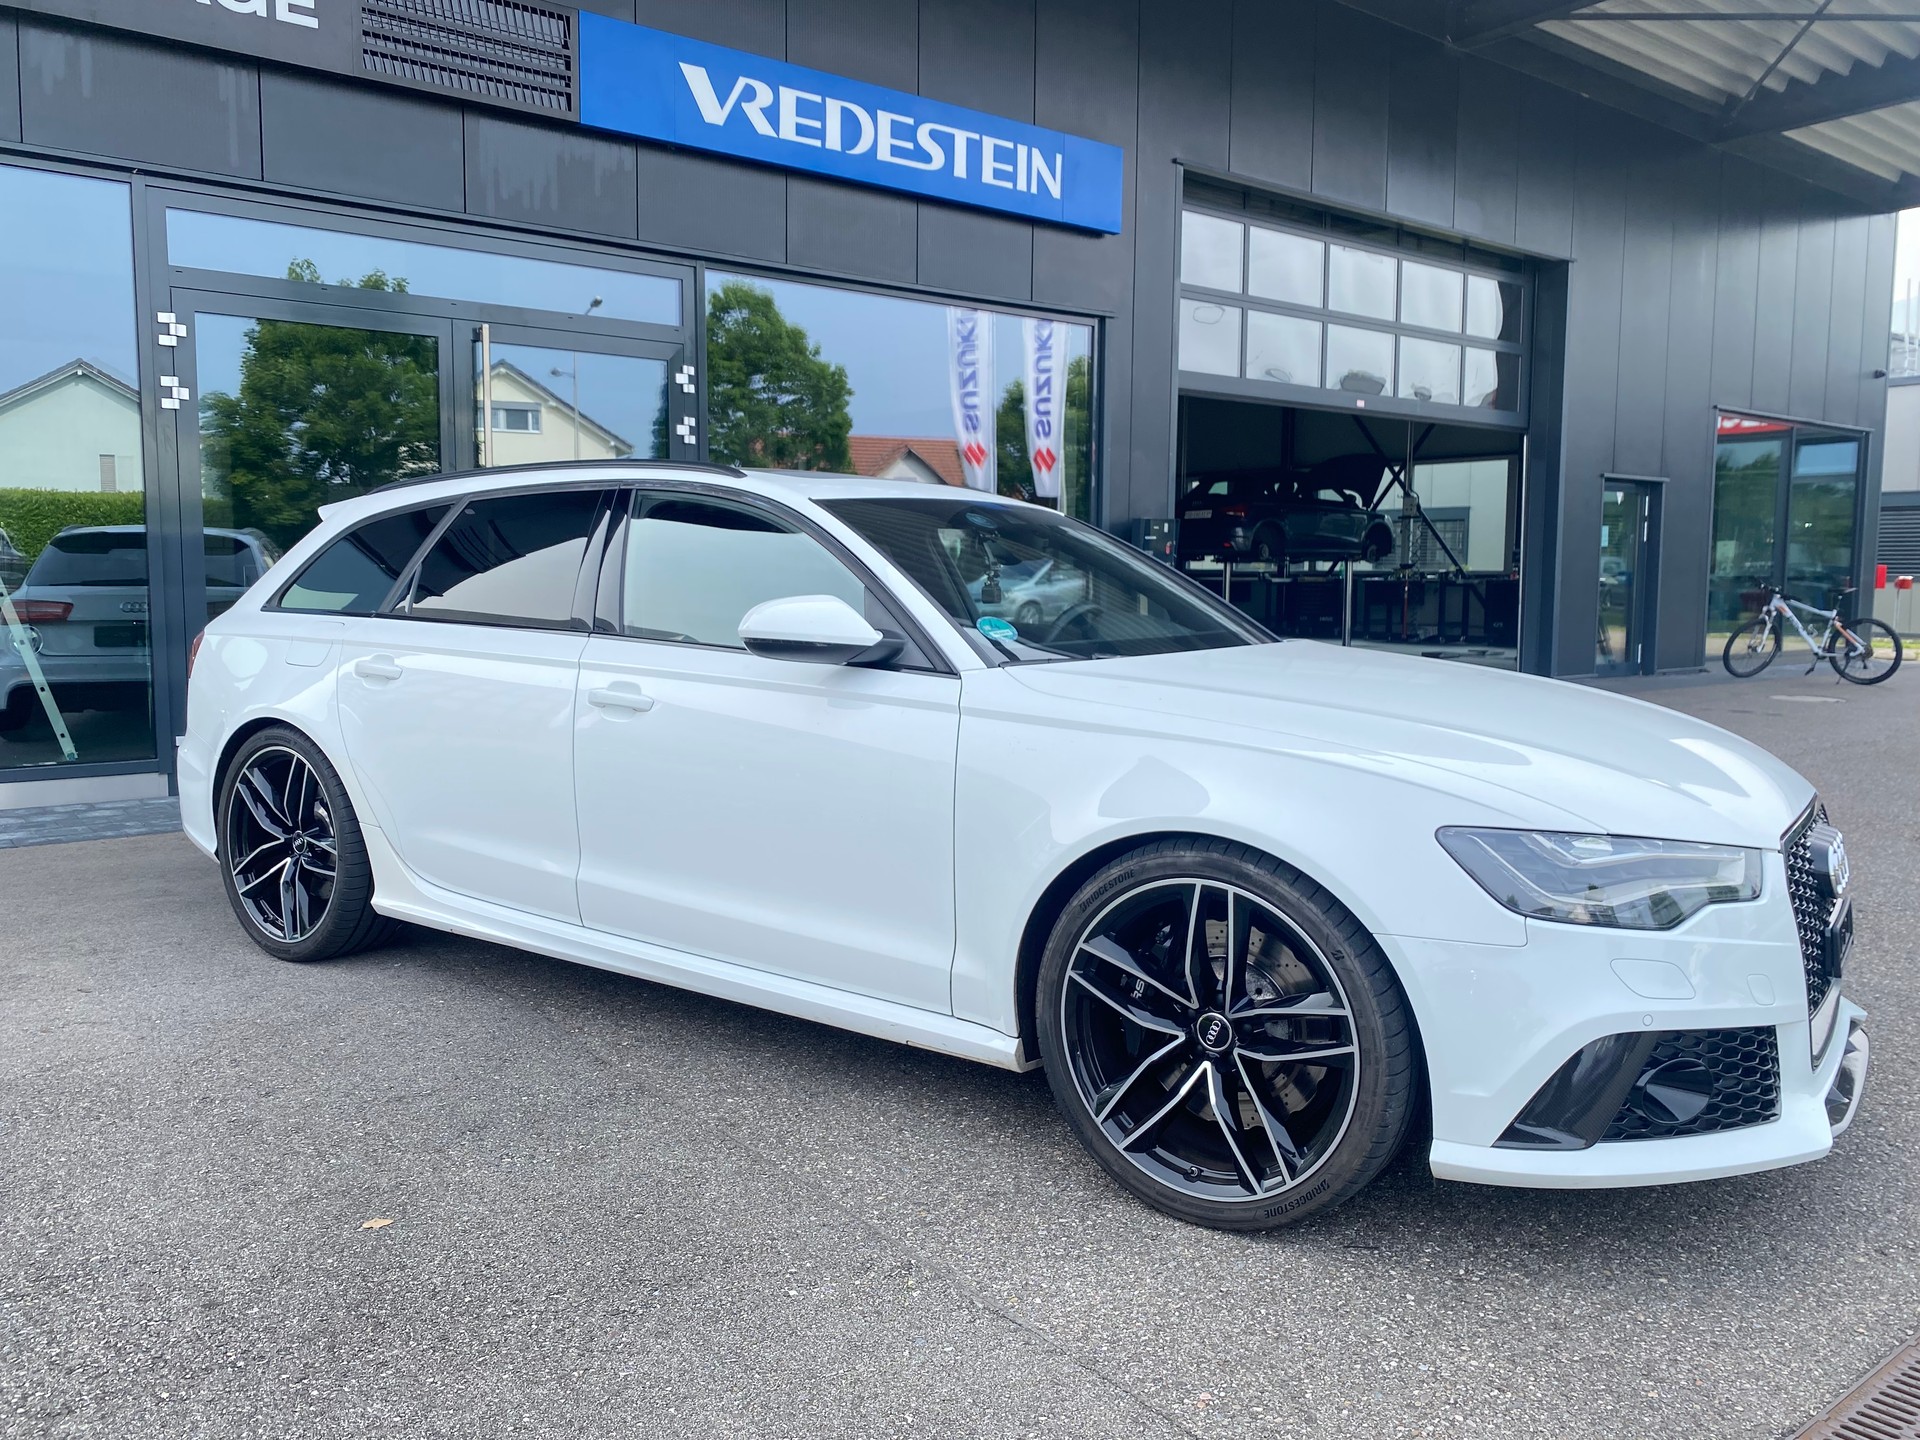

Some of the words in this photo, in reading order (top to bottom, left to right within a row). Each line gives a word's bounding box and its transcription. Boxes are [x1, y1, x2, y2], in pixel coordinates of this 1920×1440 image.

[679, 62, 1063, 200] VREDESTEIN
[1079, 869, 1136, 913] BRIDGESTONE
[1263, 1178, 1331, 1219] BRIDGESTONE
